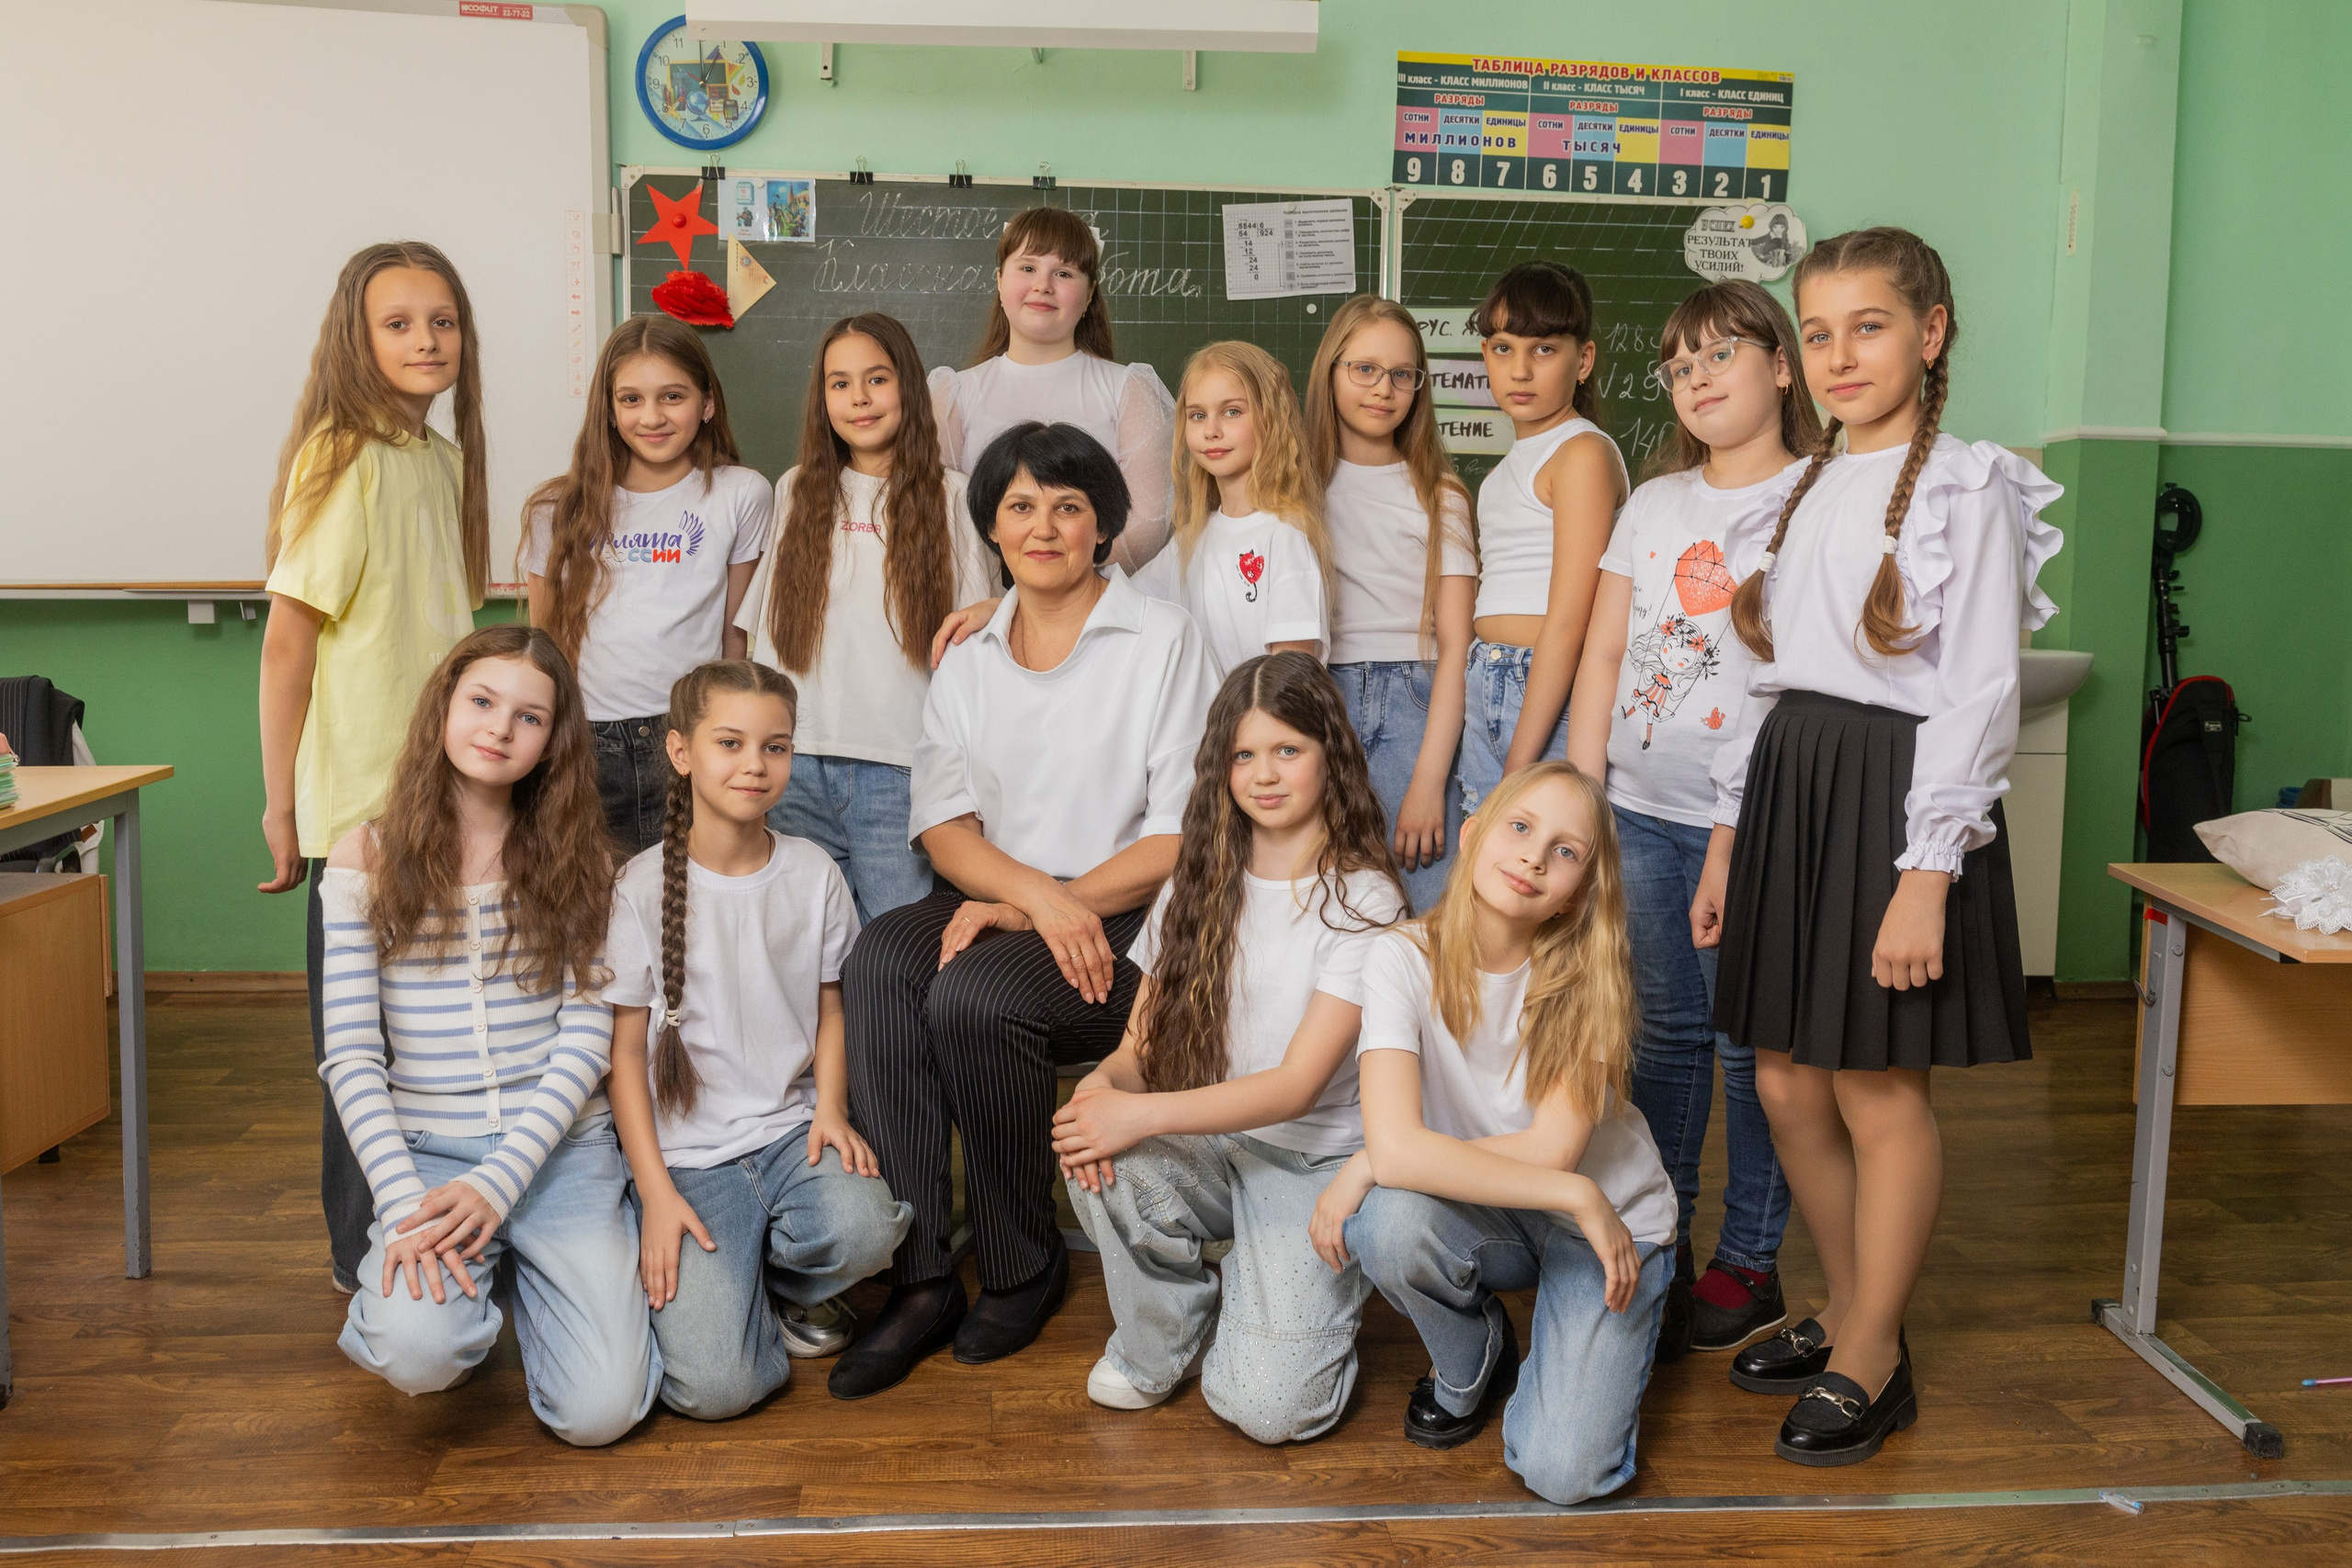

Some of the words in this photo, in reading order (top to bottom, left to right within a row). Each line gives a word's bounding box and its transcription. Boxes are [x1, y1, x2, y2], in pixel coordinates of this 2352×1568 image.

[673, 38, 684, 49] 11
[658, 55, 670, 67] 10
[738, 52, 746, 65] 2
[1472, 58, 1544, 76] ТАБЛИЦА
[1550, 62, 1630, 81] РАЗРЯДОВ
[1635, 67, 1645, 80] И
[1651, 68, 1722, 84] КЛАССОВ
[652, 78, 661, 90] 9
[746, 76, 754, 88] 3
[1397, 73, 1407, 84] III
[1408, 75, 1432, 85] класс
[1441, 75, 1470, 86] КЛАСС
[1471, 77, 1529, 89] МИЛЛИОНОВ
[1543, 81, 1550, 90] II
[1552, 83, 1577, 92] класс
[1584, 83, 1612, 94] КЛАСС
[1614, 85, 1645, 96] ТЫСЯЧ
[1434, 93, 1485, 107] РАЗРЯДЫ
[1679, 88, 1684, 97] I
[1685, 89, 1710, 98] класс
[1718, 89, 1746, 100] КЛАСС
[1747, 92, 1784, 103] ЕДИНИЦ
[662, 102, 669, 113] 8
[739, 100, 748, 111] 4
[1569, 101, 1618, 113] РАЗРЯДЫ
[1703, 107, 1753, 119] РАЗРЯДЫ
[680, 118, 686, 129] 7
[702, 123, 710, 135] 6
[725, 119, 732, 129] 5
[1404, 113, 1430, 122] СОТНИ
[1443, 115, 1480, 125] ДЕСЯТКИ
[1486, 117, 1526, 128] ЕДИНИЦЫ
[1538, 120, 1564, 130] СОТНИ
[1577, 121, 1612, 131] ДЕСЯТКИ
[1619, 124, 1659, 134] ЕДИНИЦЫ
[1669, 127, 1696, 136] СОТНИ
[1709, 129, 1745, 138] ДЕСЯТКИ
[1750, 130, 1790, 141] ЕДИНИЦЫ
[1404, 132, 1517, 149] МИЛЛИОНОВ
[1563, 140, 1622, 154] ТЫСЯЧ
[1407, 157, 1421, 183] 9
[1451, 159, 1465, 185] 8
[1497, 162, 1510, 186] 7
[1543, 164, 1557, 189] 6
[1583, 165, 1598, 190] 5
[1627, 168, 1643, 193] 4
[1672, 170, 1688, 195] 3
[1713, 172, 1729, 197] 2
[1760, 175, 1771, 199] 1
[860, 191, 1000, 240] Шестое
[1701, 219, 1736, 232] УСПЕХ
[1687, 235, 1752, 248] РЕЗУЛЬТАТ
[1700, 249, 1739, 261] ТВОИХ
[1694, 260, 1744, 273] УСИЛИЙ!
[1098, 251, 1202, 298] бота.
[1430, 372, 1491, 389] ТЕМАТ
[1437, 421, 1494, 437] ТЕНИЕ
